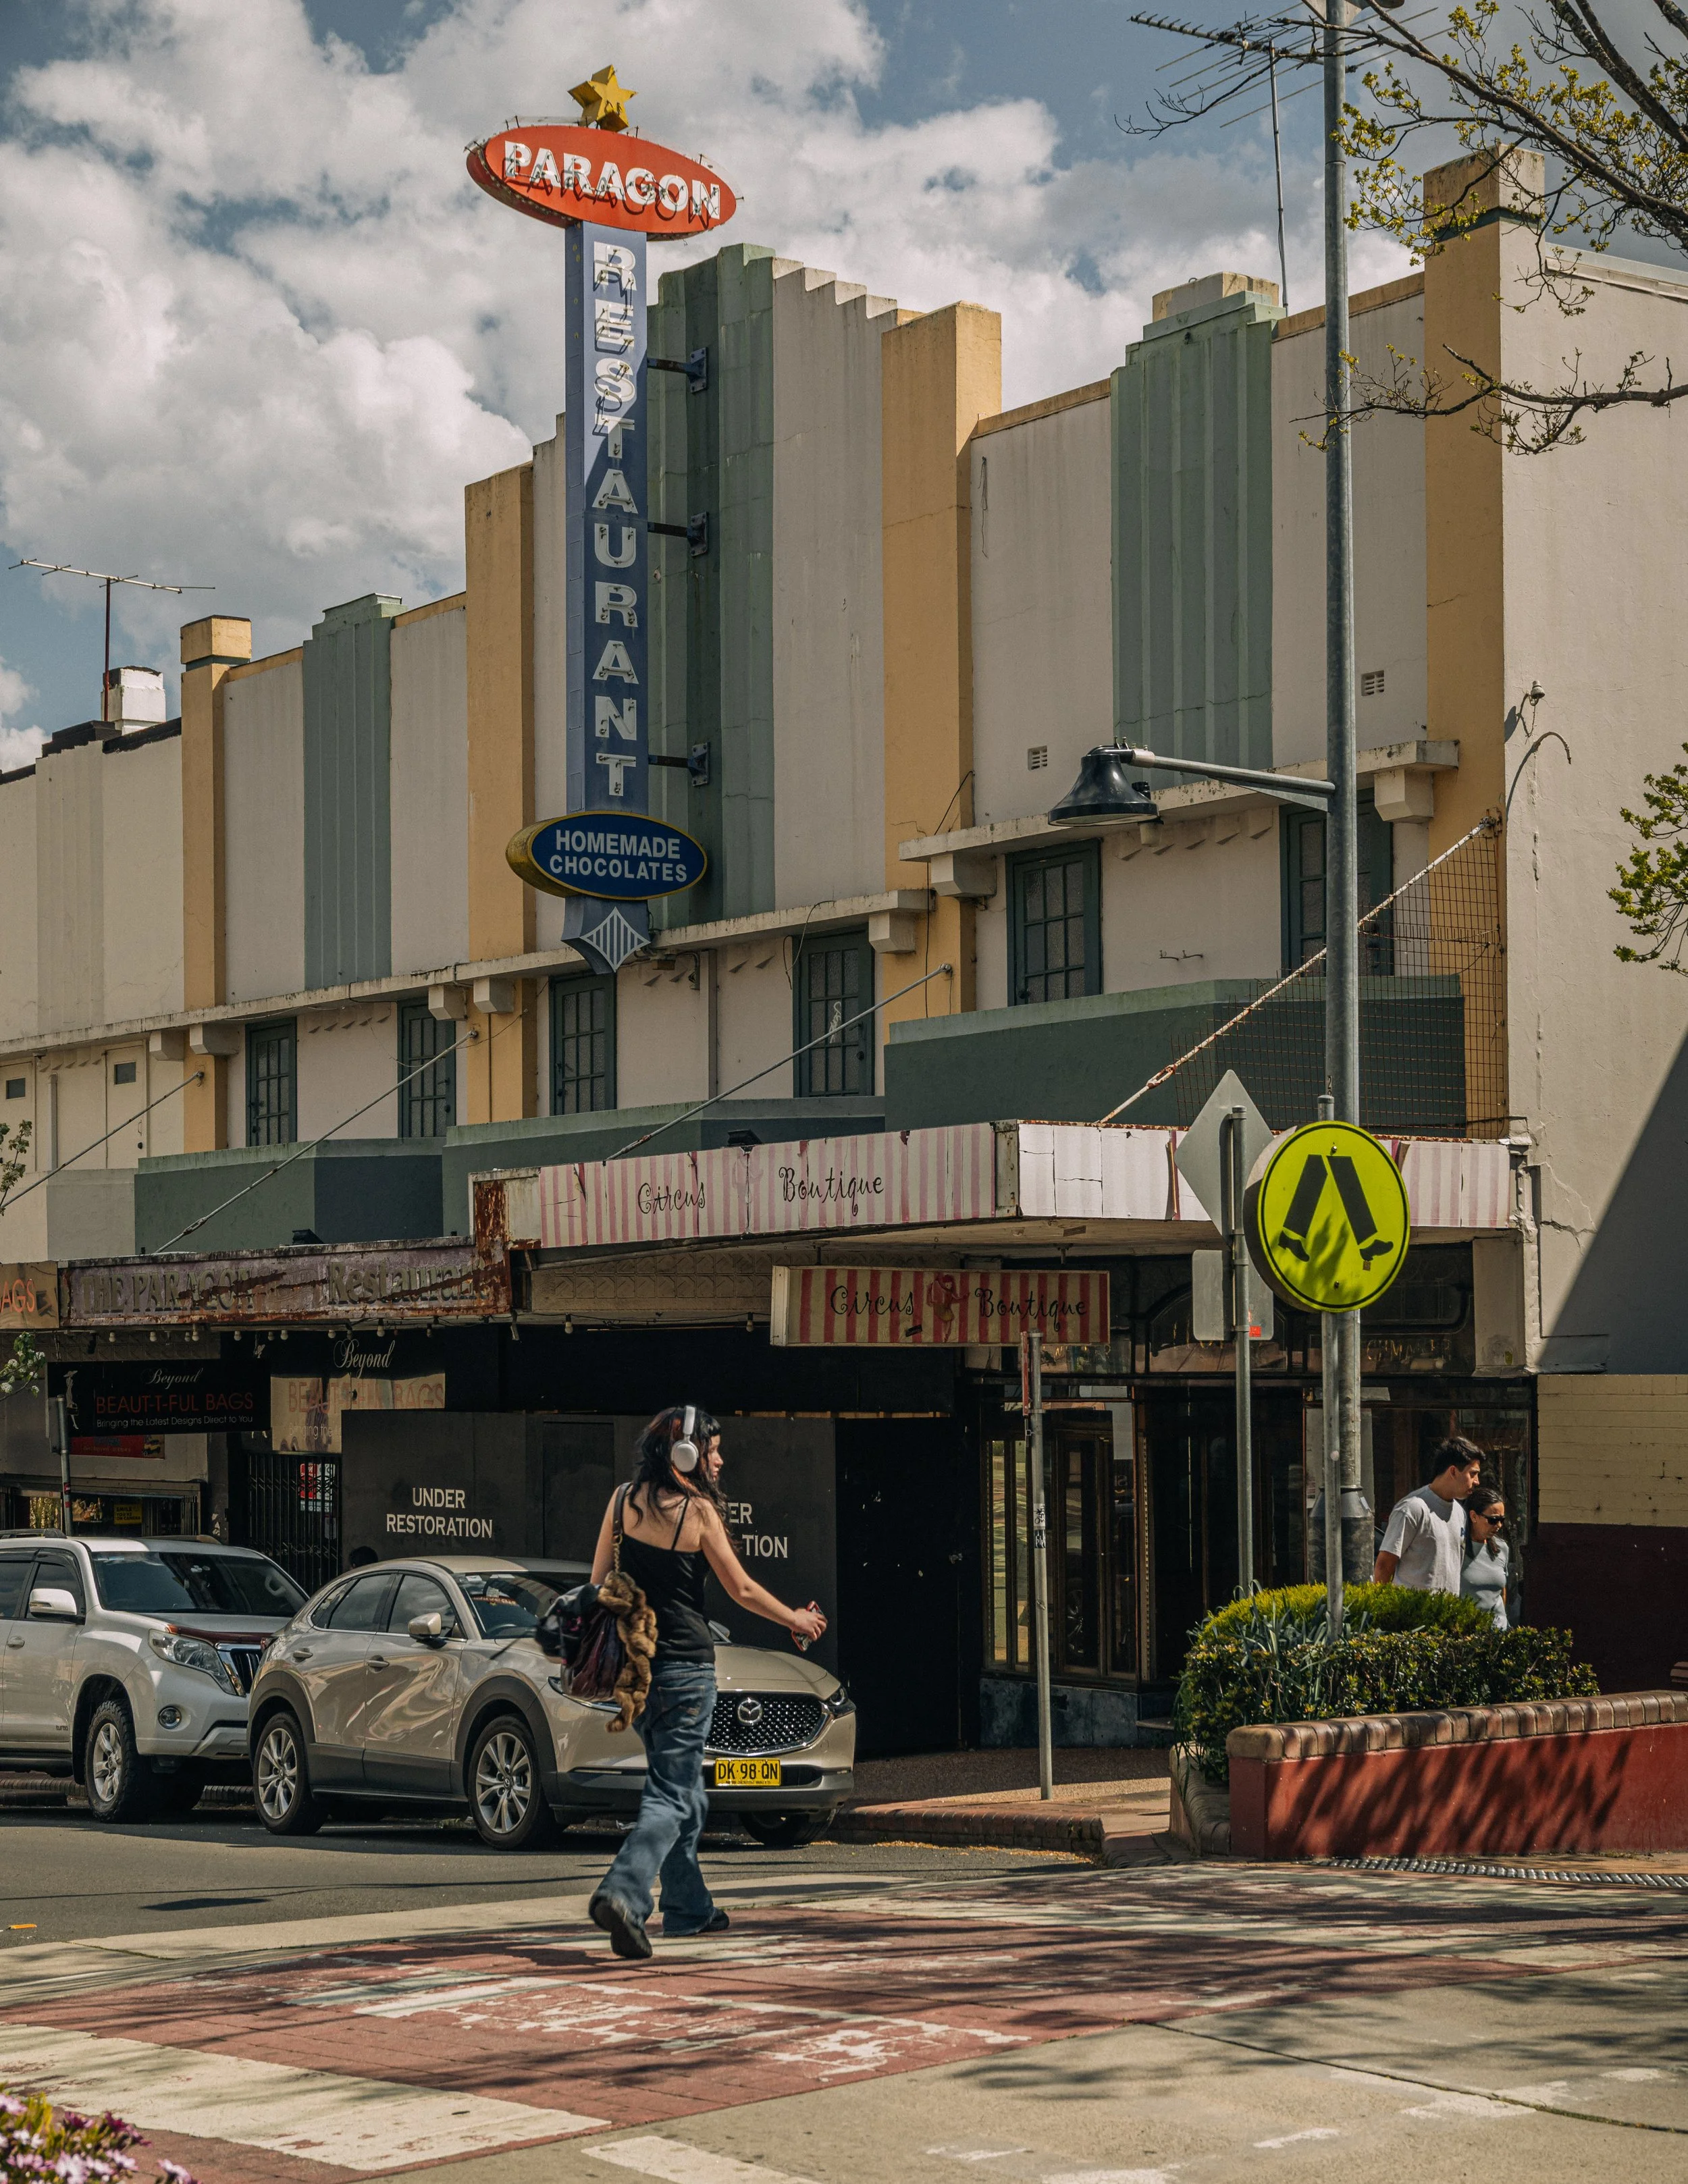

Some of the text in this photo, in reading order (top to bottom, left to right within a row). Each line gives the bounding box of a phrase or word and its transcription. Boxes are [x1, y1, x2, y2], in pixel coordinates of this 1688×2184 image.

[505, 140, 720, 219] PARAGON
[591, 241, 639, 797] RESTAURANT
[556, 829, 681, 859] HOMEMADE
[550, 855, 687, 882] CHOCOLATES
[638, 1167, 885, 1216] Circus Boutique
[0, 1277, 36, 1313] AGS
[81, 1274, 124, 1314] THE
[830, 1285, 1087, 1331] Circus Boutique
[333, 1339, 396, 1379] Beyond
[140, 1367, 204, 1389] Beyond
[205, 1392, 254, 1411] BAGS
[97, 1418, 128, 1428] Bringing
[130, 1418, 144, 1426] the
[146, 1417, 169, 1426] Latest
[171, 1416, 202, 1427] Designs
[204, 1415, 228, 1424] Direct
[238, 1414, 253, 1423] You
[413, 1487, 466, 1509] UNDER
[386, 1513, 493, 1539] RESTORATION
